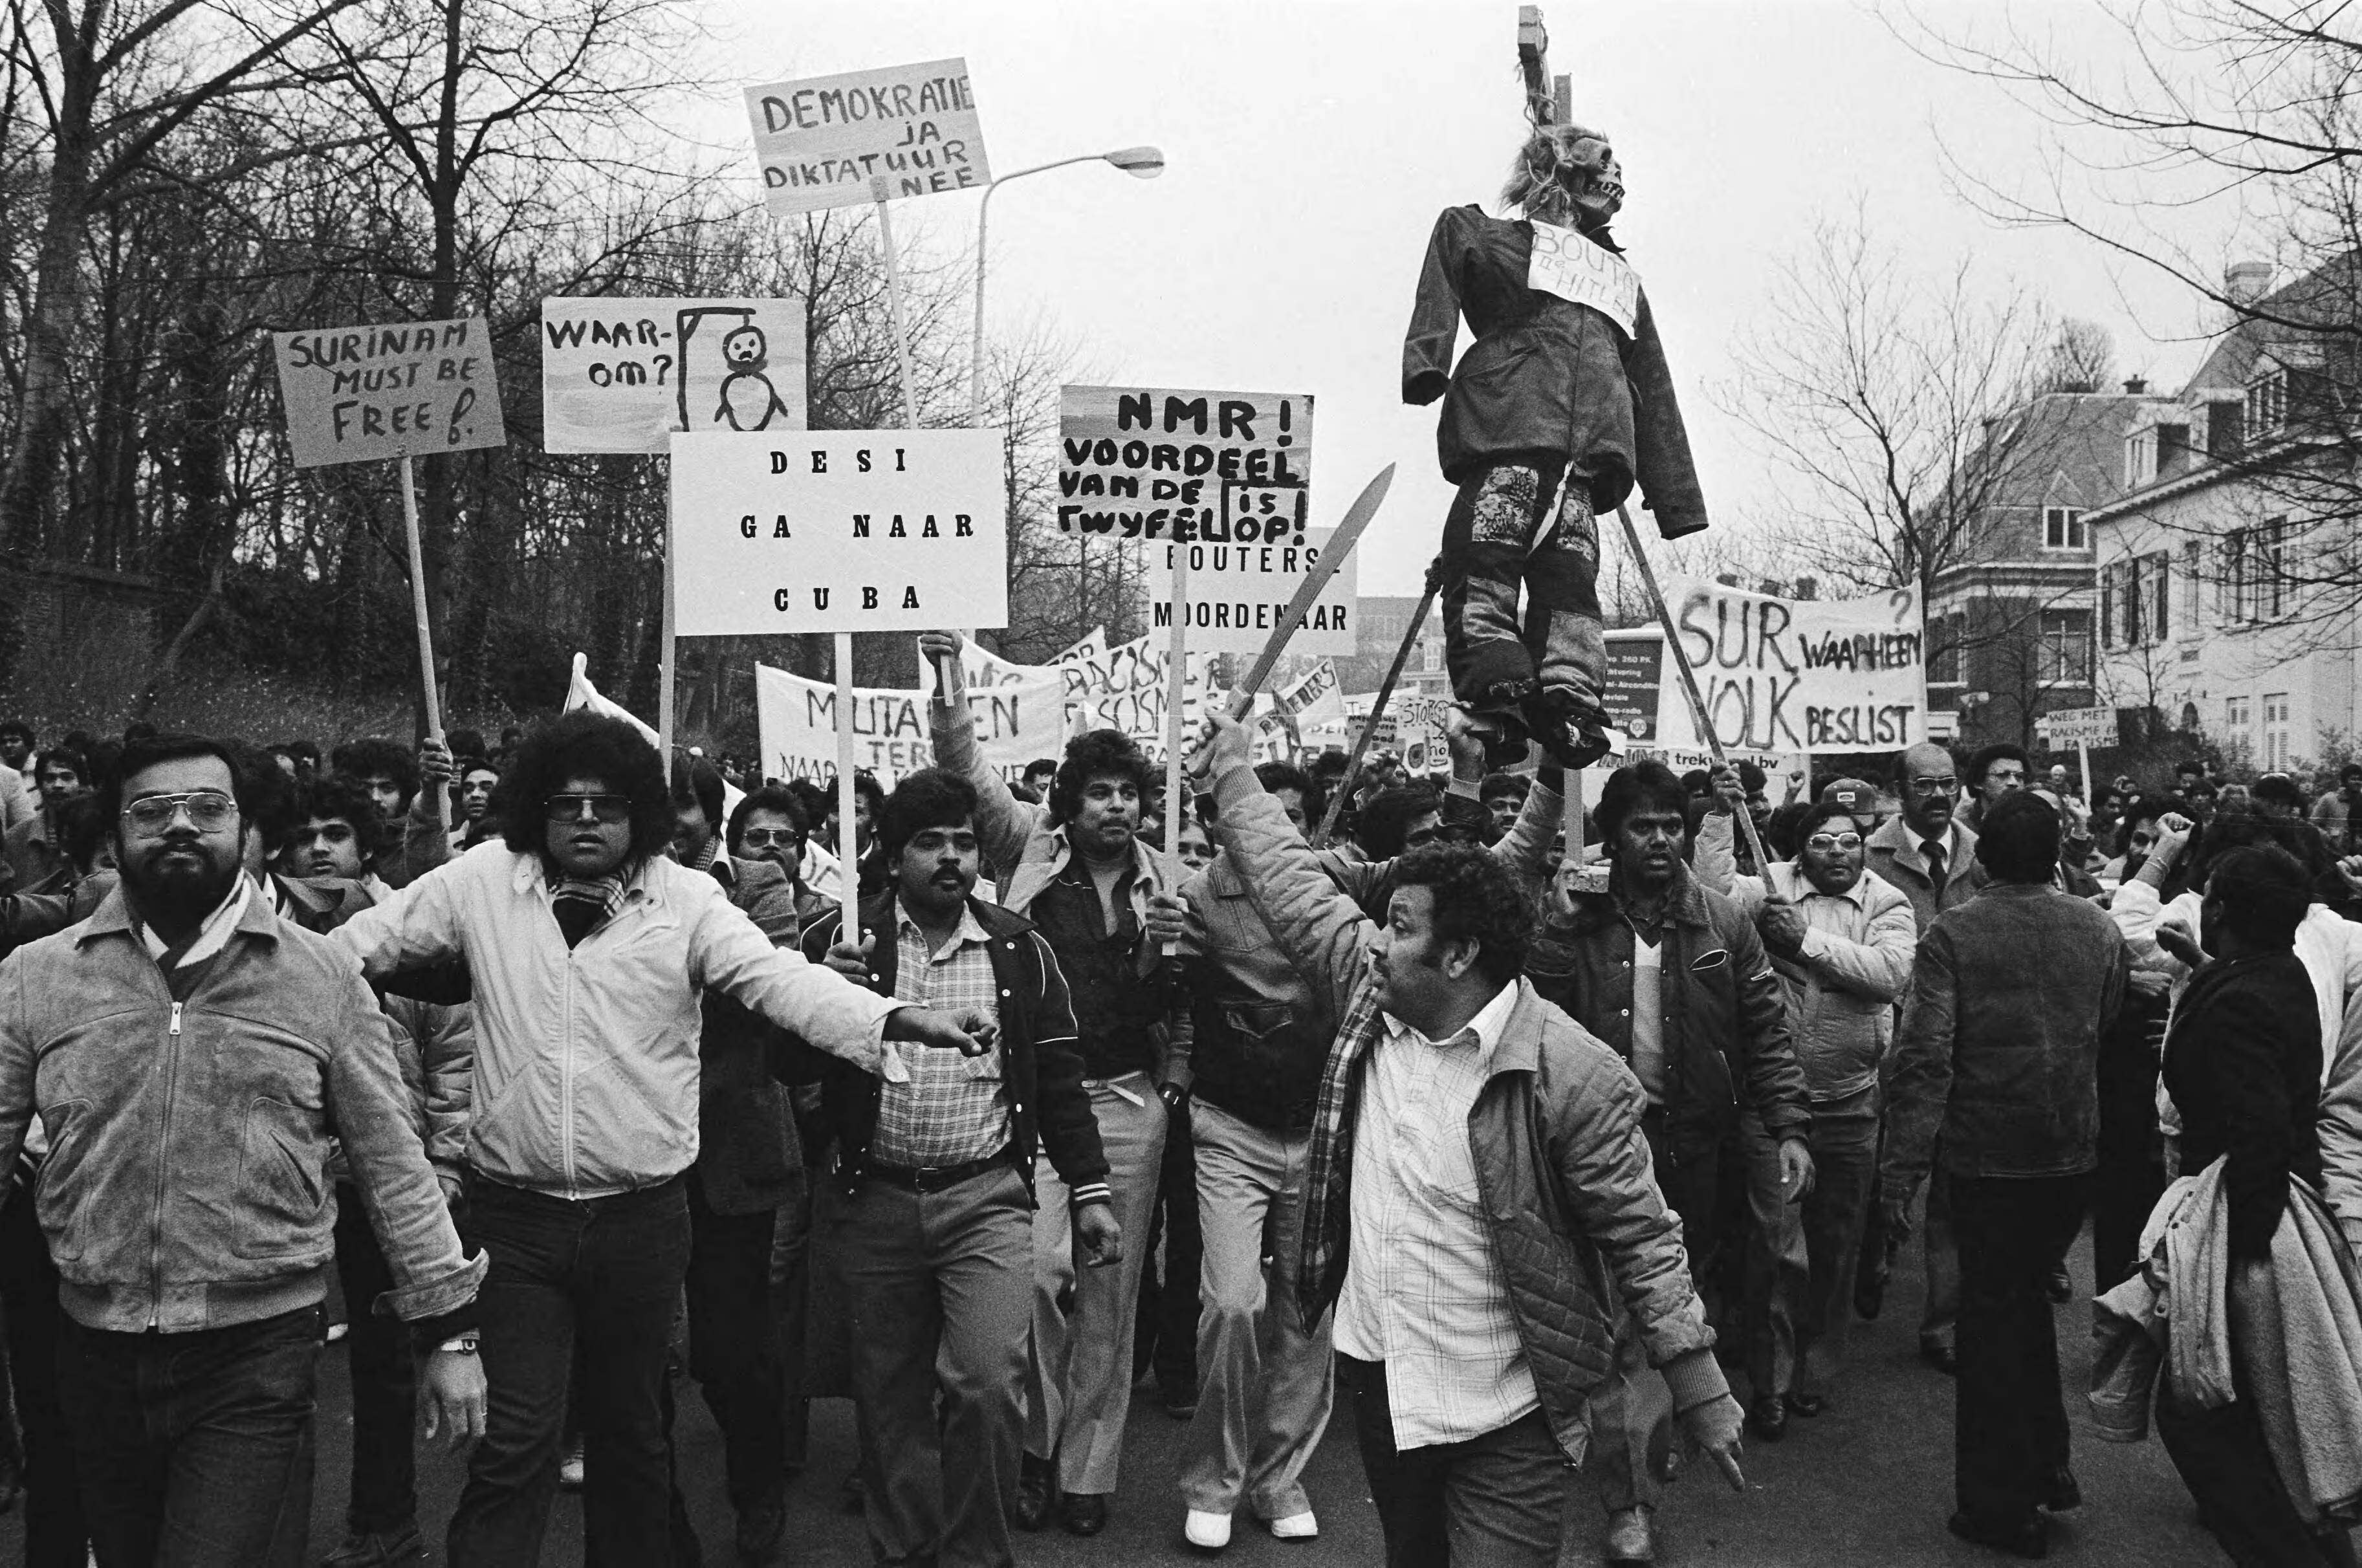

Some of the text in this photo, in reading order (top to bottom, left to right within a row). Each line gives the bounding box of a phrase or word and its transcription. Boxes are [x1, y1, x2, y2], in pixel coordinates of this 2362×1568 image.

[761, 74, 976, 134] DEMOKRATIE
[763, 138, 969, 190] DIKTATUUR
[901, 166, 979, 197] NEE
[287, 320, 470, 369] SURINAM
[545, 317, 673, 350] WAAR-
[333, 357, 477, 395] MUST BE
[333, 398, 432, 442] FREE
[769, 448, 906, 474] DESI
[1064, 437, 1300, 484] VOORDEEL
[1058, 470, 1139, 499] VAN
[1152, 478, 1205, 505] DE
[740, 514, 974, 538] GA NAAR
[1166, 545, 1340, 574] OUTERS
[774, 585, 920, 612] CUBA
[1680, 589, 1799, 677] SUR
[1064, 686, 1199, 734] FSCISME
[1675, 673, 1916, 750] VOLK BESLIST
[2081, 709, 2106, 721] MET
[2050, 725, 2099, 739] RACISME
[1759, 755, 1779, 769] bv
